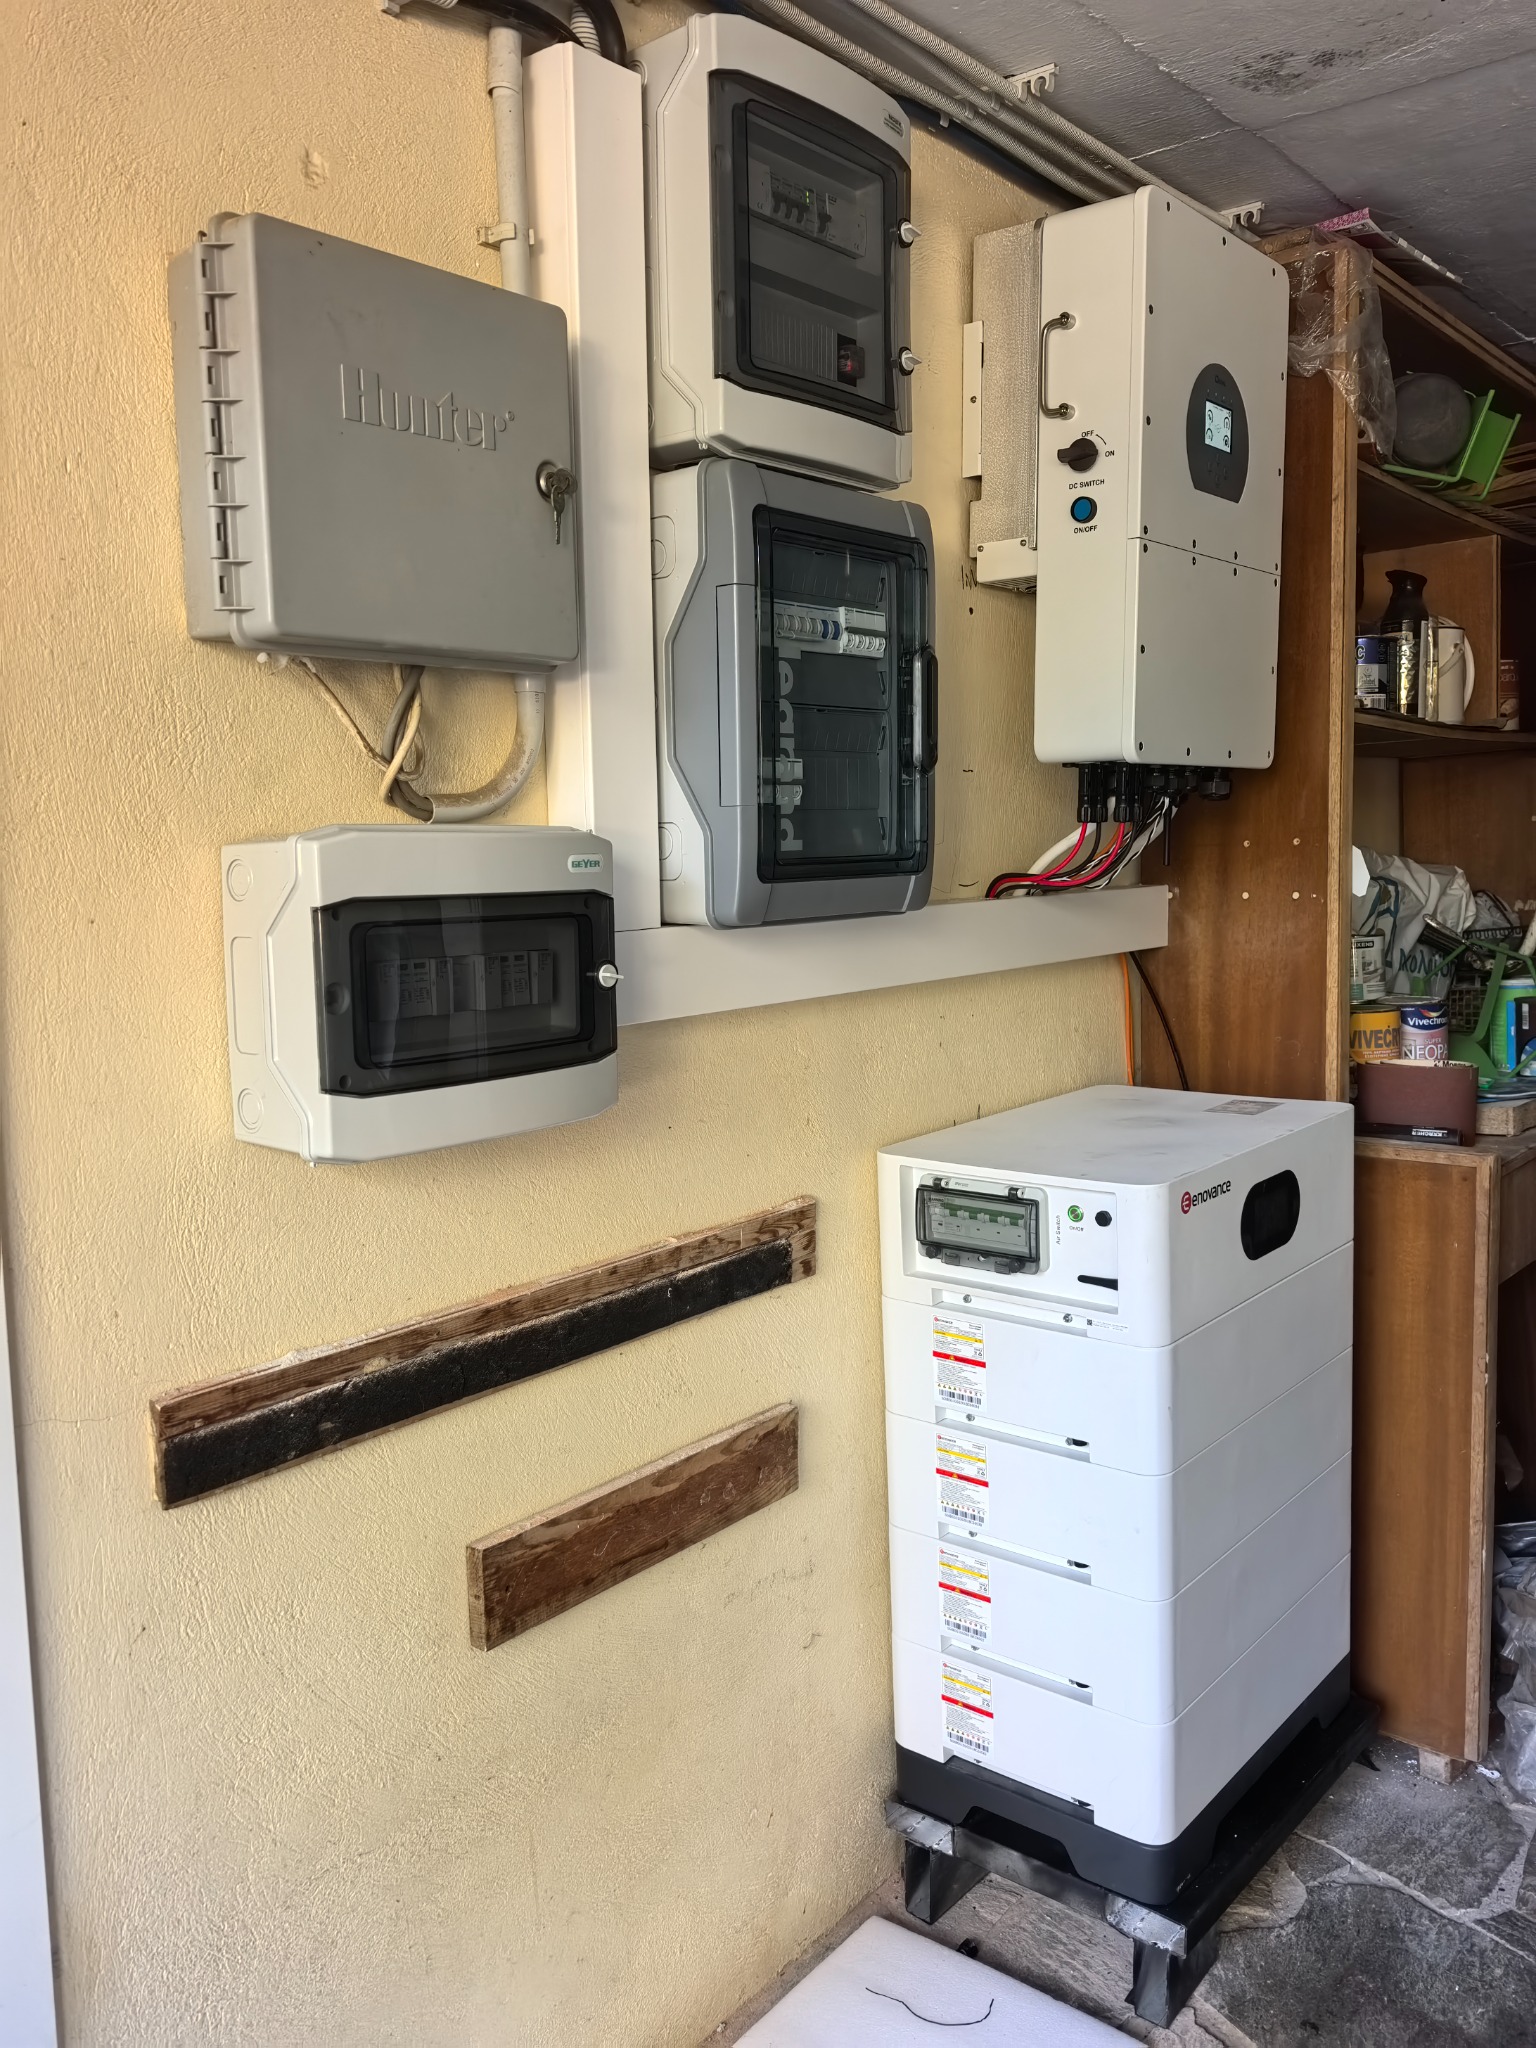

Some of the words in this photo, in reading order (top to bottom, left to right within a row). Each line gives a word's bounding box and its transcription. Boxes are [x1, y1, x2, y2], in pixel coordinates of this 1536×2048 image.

[1081, 430, 1094, 438] OFF
[1068, 482, 1078, 490] DC
[1079, 479, 1105, 488] SWITCH
[1073, 525, 1098, 534] ON/OFF
[571, 859, 600, 868] GEYER
[1192, 1180, 1231, 1207] enovance
